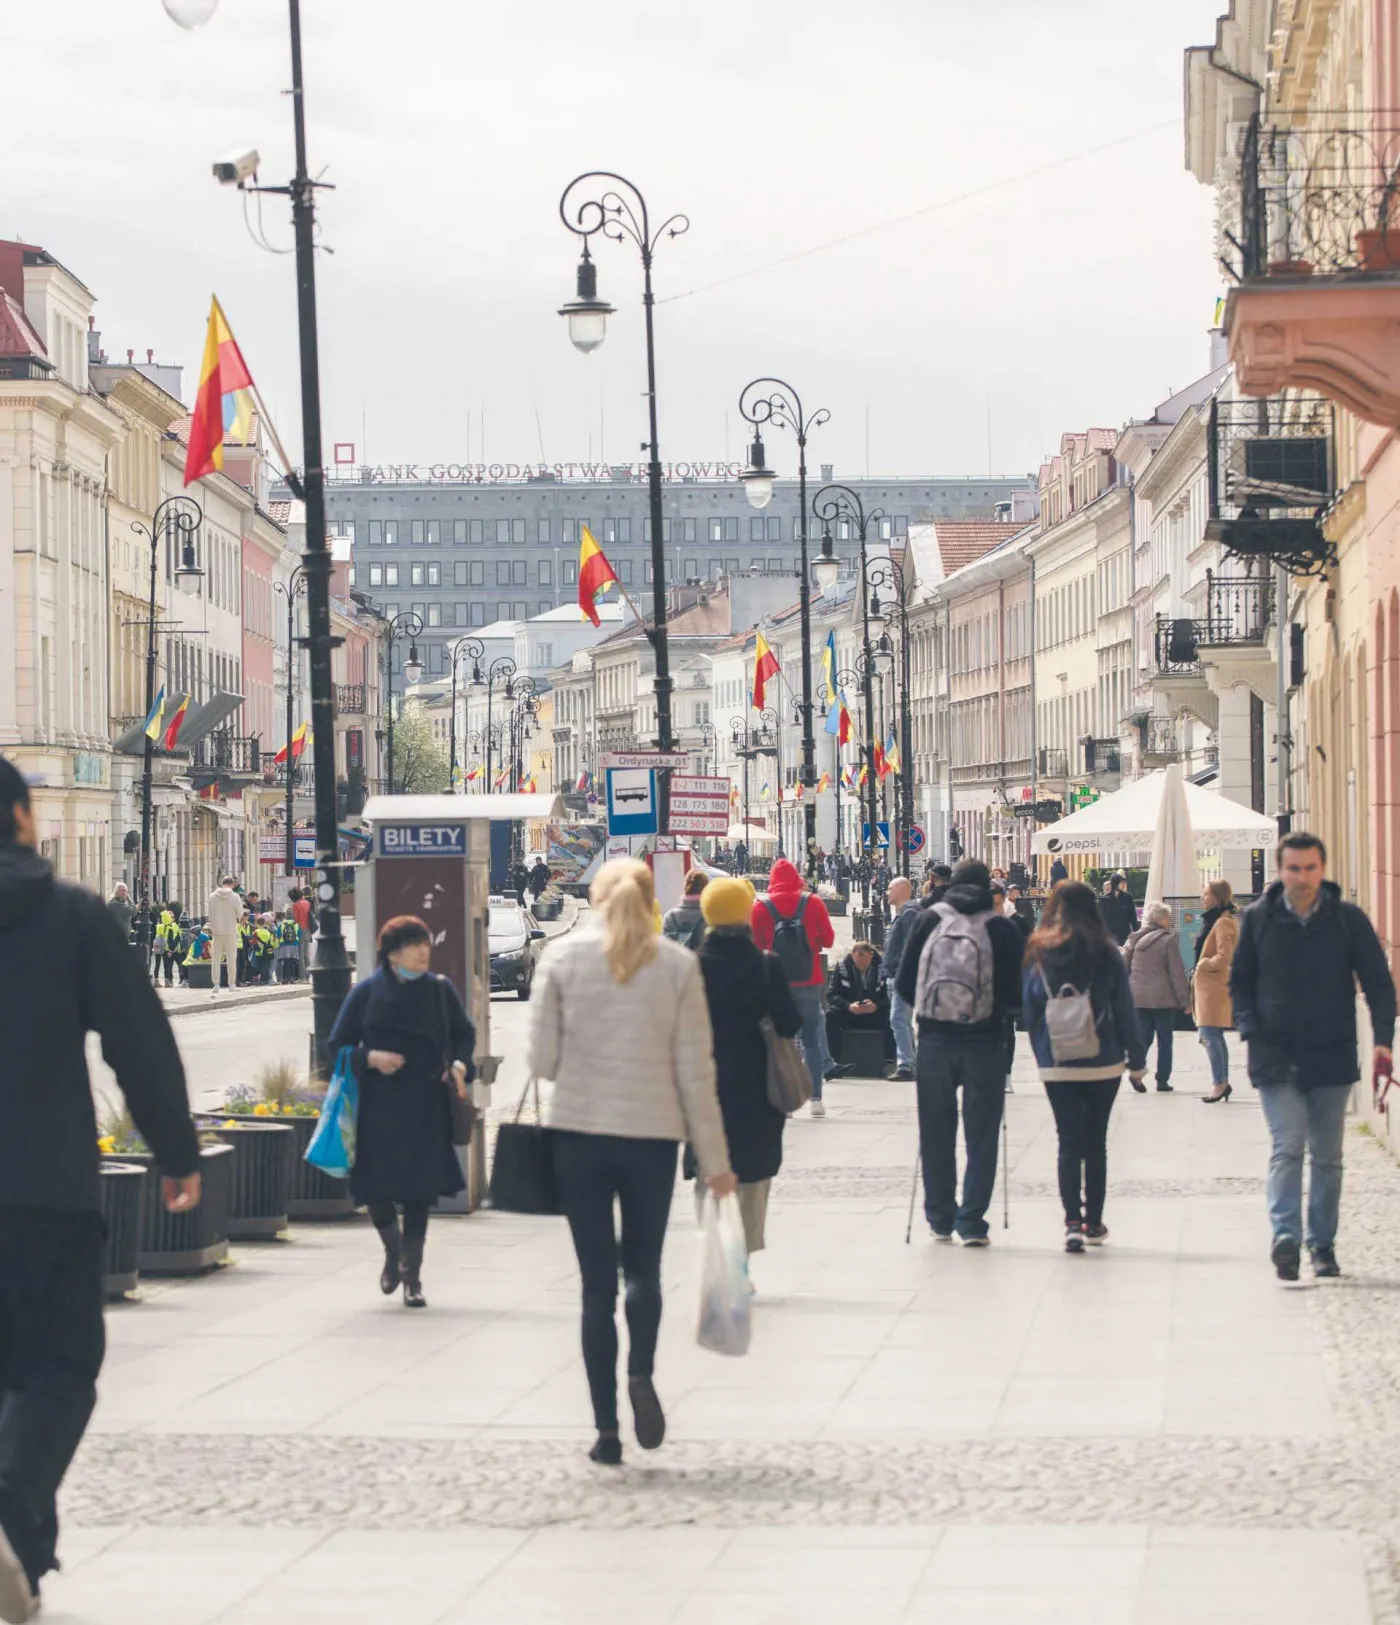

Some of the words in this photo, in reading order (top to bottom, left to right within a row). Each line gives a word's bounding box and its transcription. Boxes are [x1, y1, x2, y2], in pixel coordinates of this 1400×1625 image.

[430, 463, 611, 480] GOSPODARSTWA
[618, 756, 670, 766] Ordynacka
[674, 757, 687, 766] 01
[694, 781, 707, 790] 111
[712, 781, 726, 791] 116
[673, 799, 688, 809] 128
[692, 800, 707, 810] 175
[711, 800, 726, 810] 180
[671, 819, 687, 828] 222
[710, 820, 725, 829] 518
[384, 828, 461, 846] BILETY
[1065, 837, 1102, 851] pepsi
